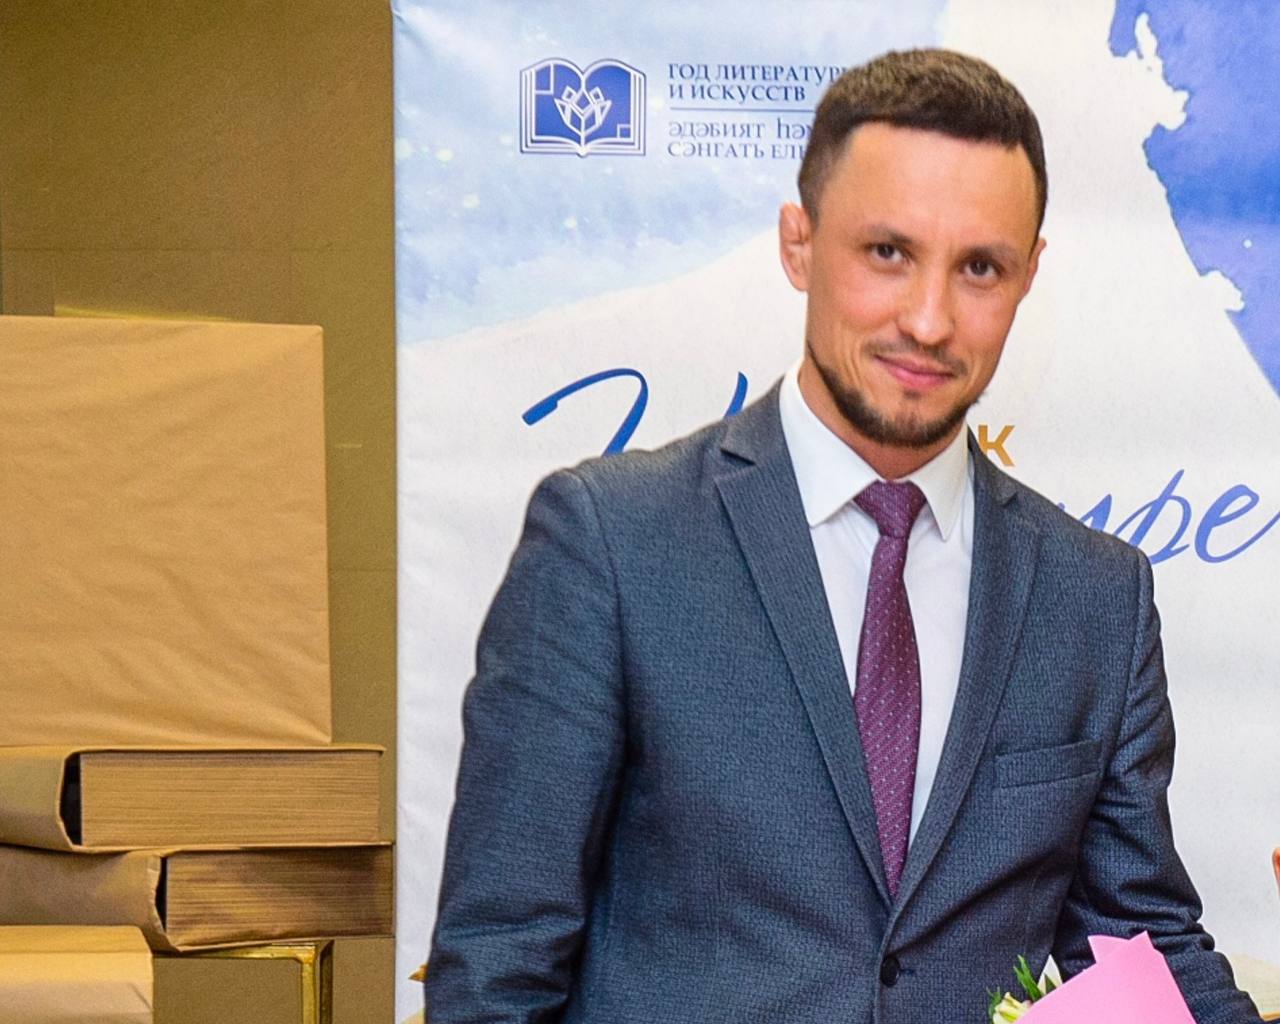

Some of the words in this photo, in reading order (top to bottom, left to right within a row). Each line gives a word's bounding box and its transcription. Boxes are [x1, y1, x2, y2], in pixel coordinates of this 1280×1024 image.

[668, 64, 711, 83] ГОД
[669, 84, 684, 100] И
[691, 84, 806, 105] ИСКУССТВ
